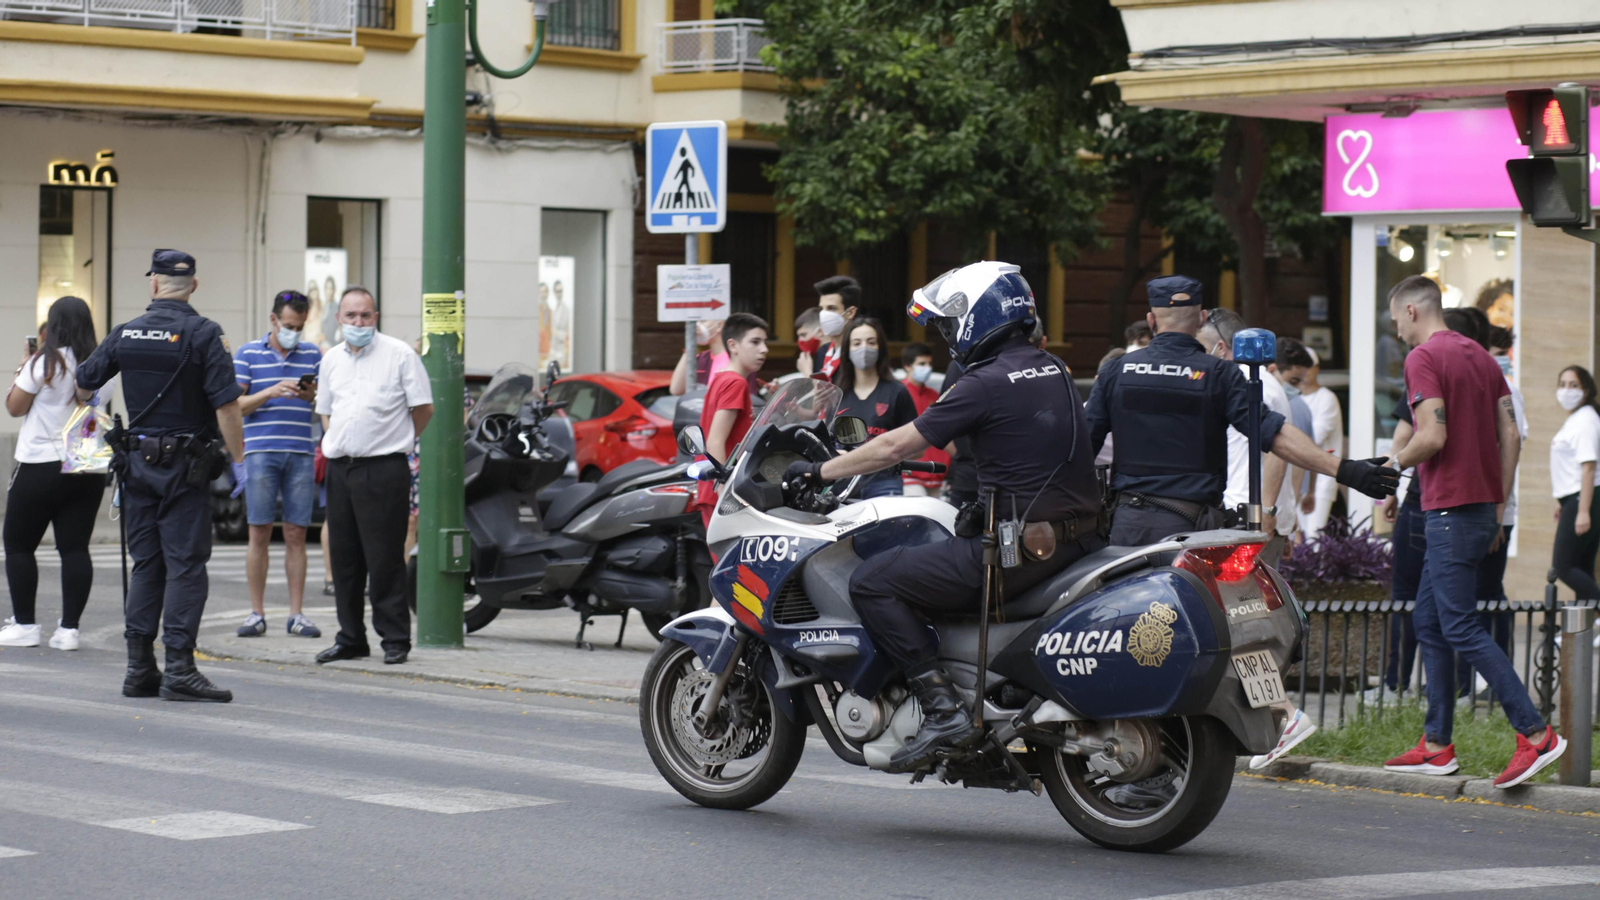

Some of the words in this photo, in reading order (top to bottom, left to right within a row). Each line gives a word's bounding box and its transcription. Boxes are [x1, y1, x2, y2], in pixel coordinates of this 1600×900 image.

[49, 150, 118, 186] mó
[121, 329, 172, 341] POLICIA
[964, 313, 976, 341] CNP
[1007, 365, 1062, 383] POLICI
[1122, 363, 1193, 377] POLICIA
[799, 629, 840, 643] POLICIA
[1035, 630, 1123, 655] POLICIA
[1056, 657, 1098, 677] CNP
[1235, 655, 1258, 679] CNP
[1258, 653, 1277, 674] AL
[1249, 678, 1281, 703] 4191
